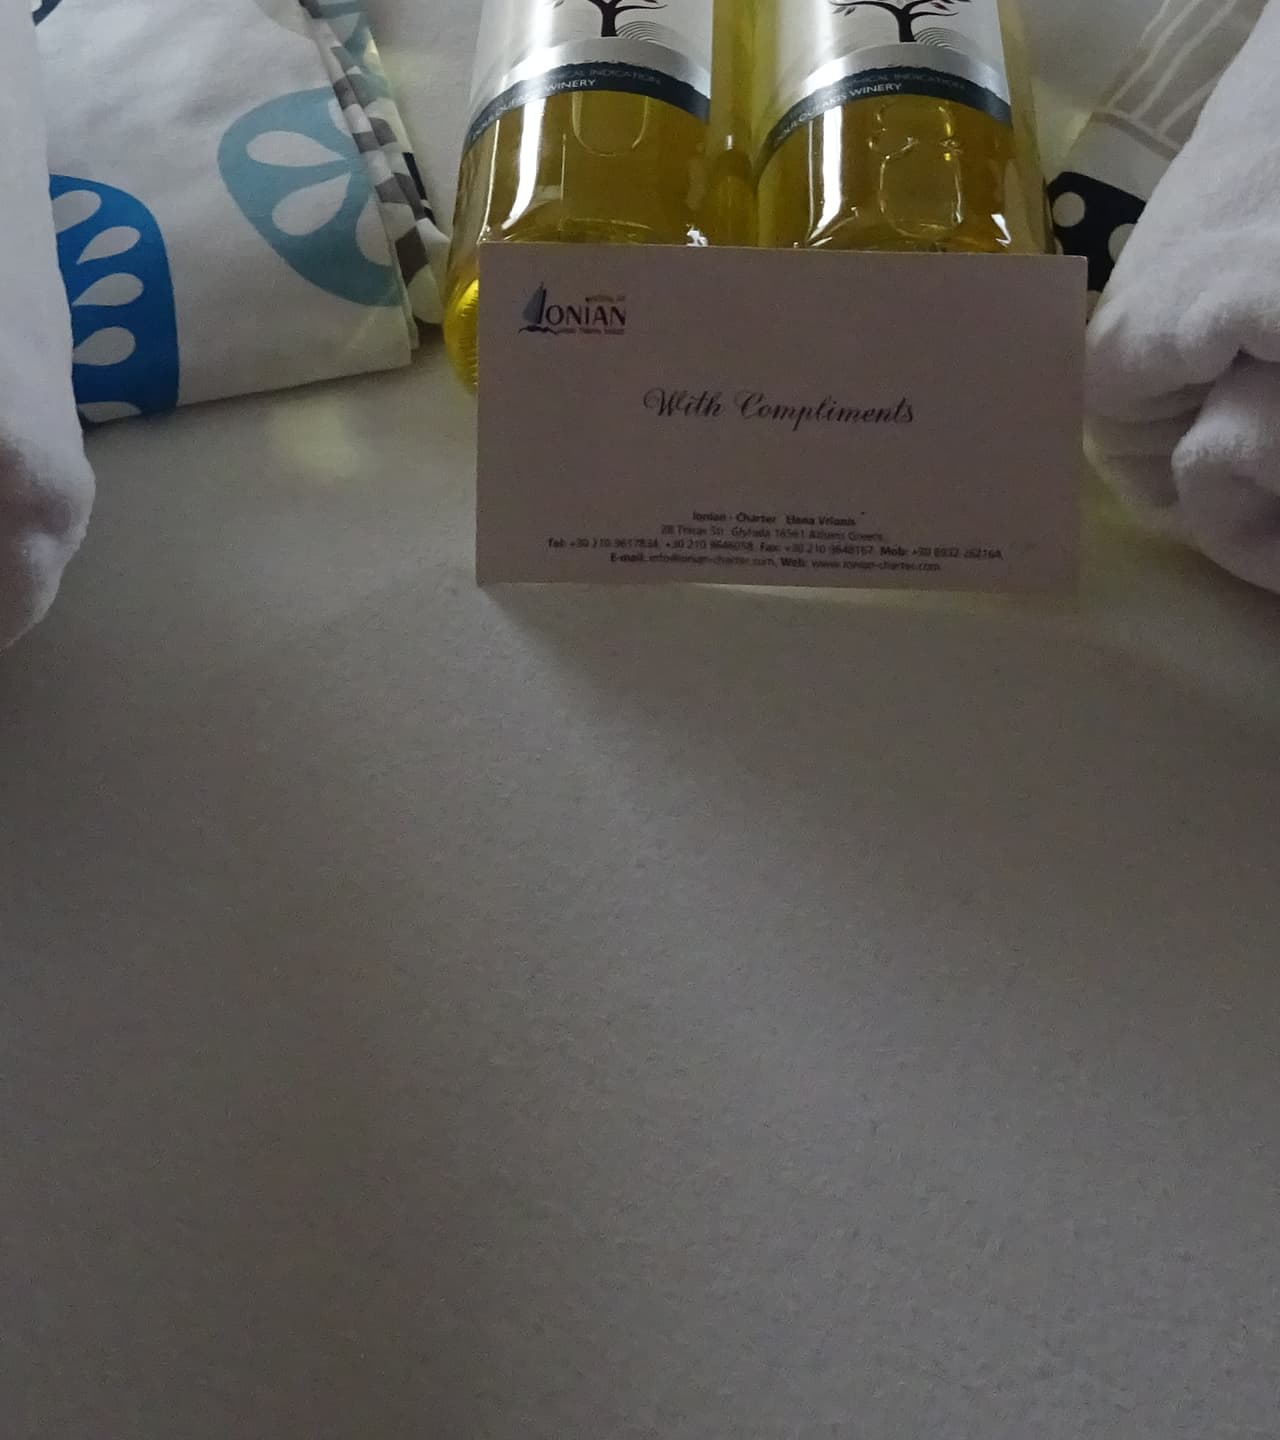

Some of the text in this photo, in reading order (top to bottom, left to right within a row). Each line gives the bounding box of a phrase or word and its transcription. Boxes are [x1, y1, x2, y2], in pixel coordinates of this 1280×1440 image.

[545, 79, 596, 92] WINERY
[849, 83, 902, 96] WINERY
[643, 387, 914, 431] With Compliments
